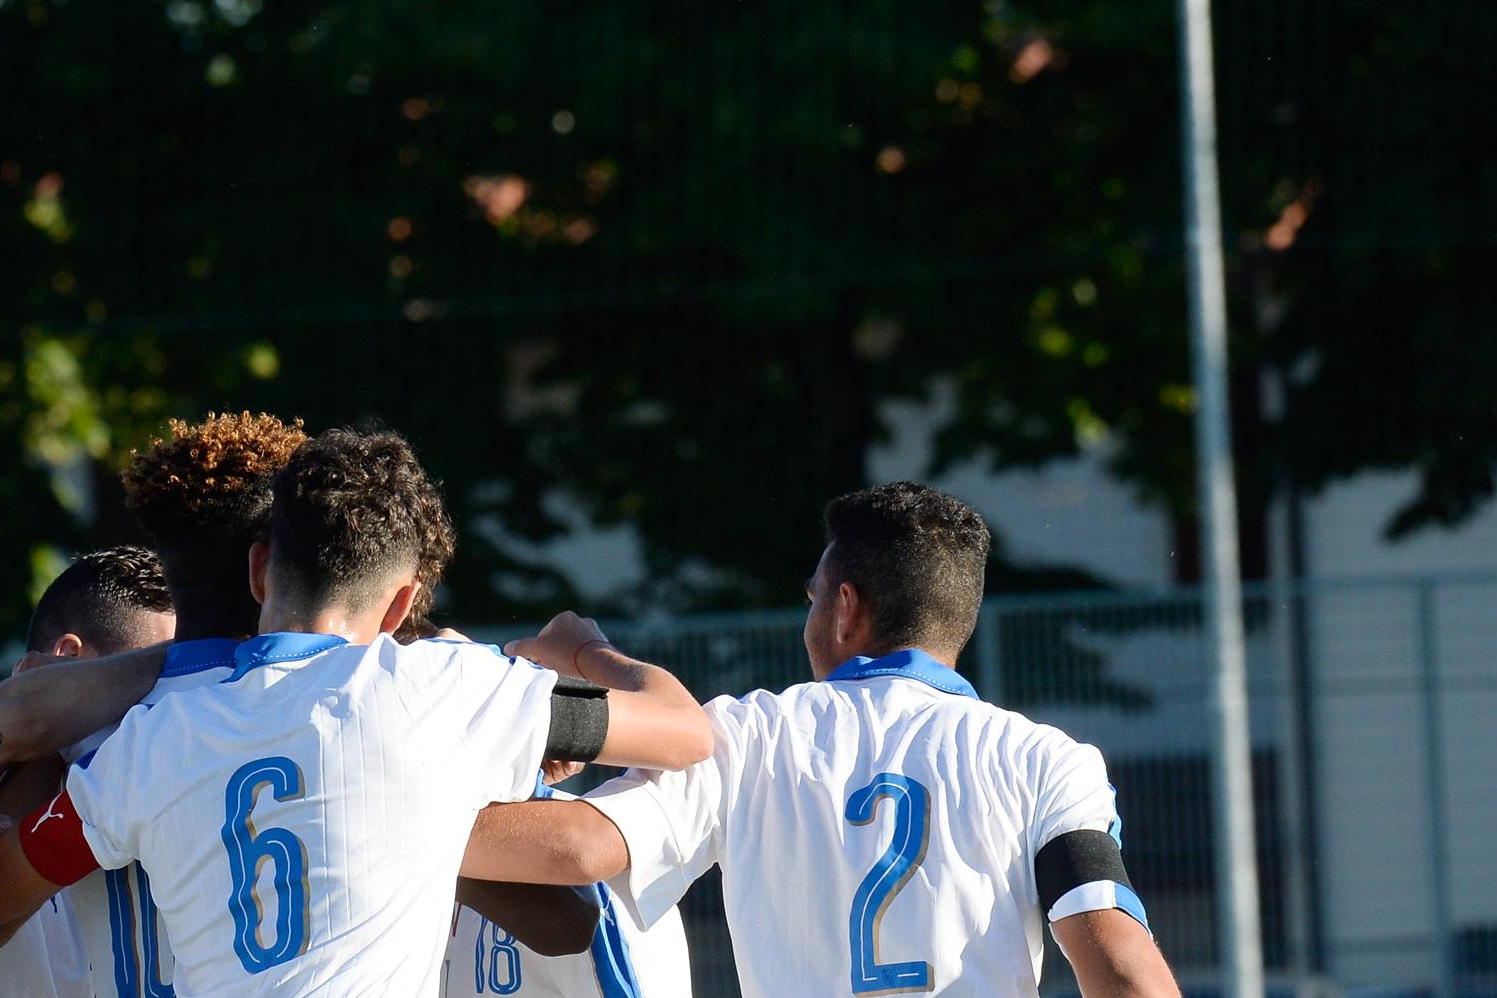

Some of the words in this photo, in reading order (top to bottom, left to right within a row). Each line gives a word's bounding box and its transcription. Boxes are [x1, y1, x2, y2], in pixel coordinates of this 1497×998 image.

[221, 757, 310, 975] 6
[475, 914, 522, 995] 18
[845, 772, 934, 998] 2
